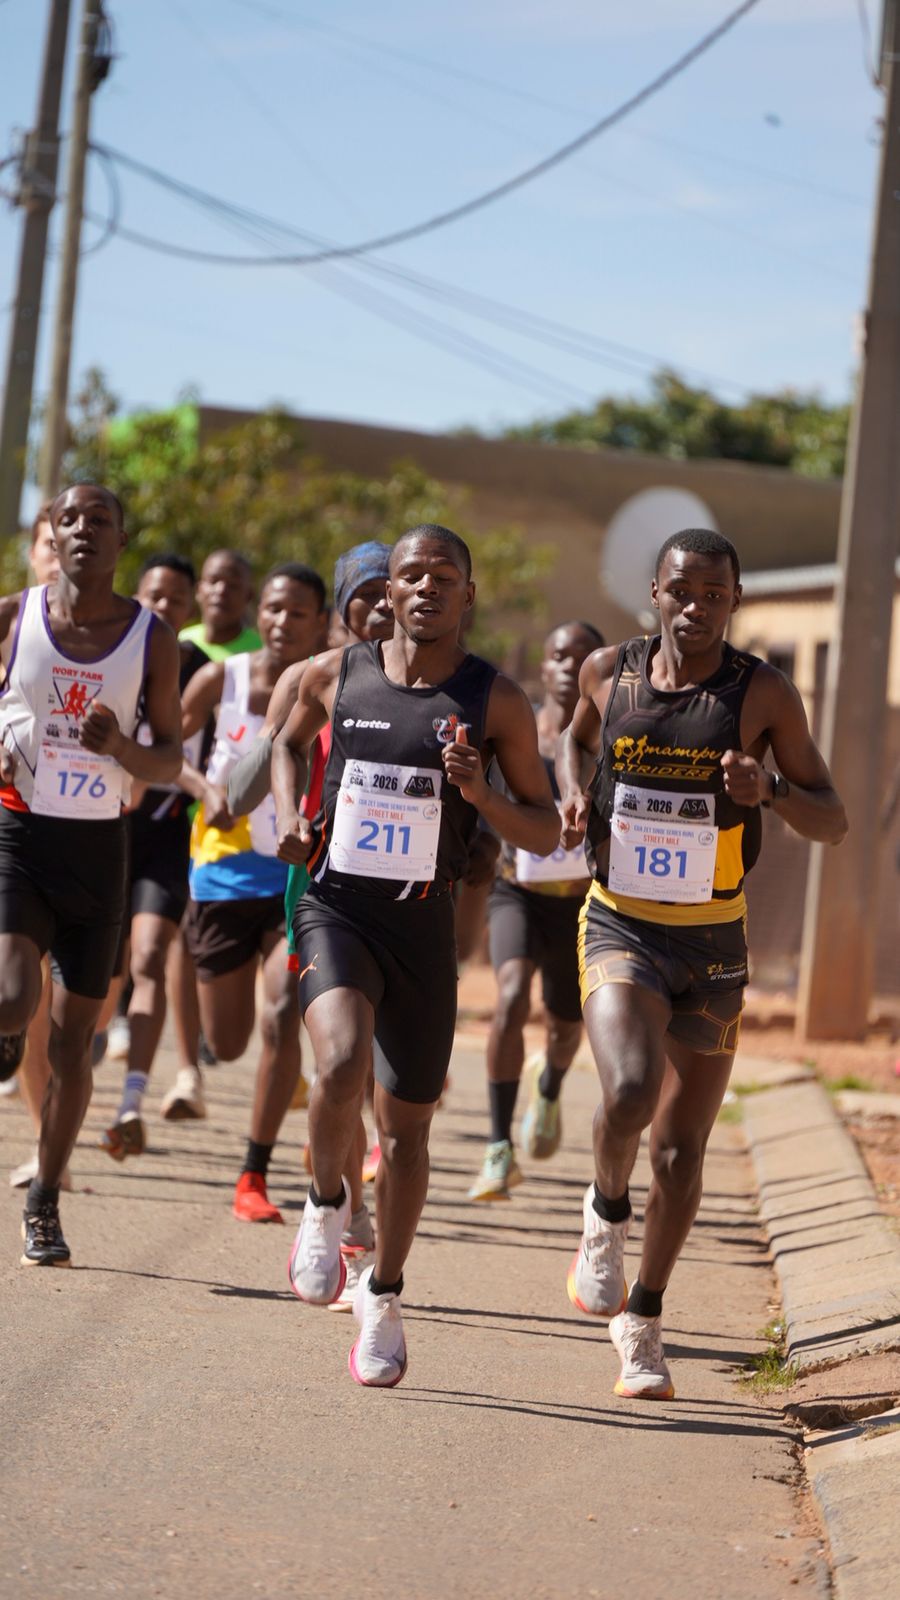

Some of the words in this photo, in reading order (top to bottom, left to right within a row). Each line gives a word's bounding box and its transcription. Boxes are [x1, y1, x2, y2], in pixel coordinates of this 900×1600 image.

[52, 666, 79, 677] IVORY
[80, 670, 104, 681] PARK
[355, 720, 391, 729] lotto
[612, 762, 714, 778] STRIDERS
[57, 771, 107, 799] 176
[373, 774, 398, 792] 2026
[408, 777, 433, 790] ASA
[367, 808, 389, 819] STREET
[390, 811, 404, 821] MILE
[646, 798, 673, 815] 2026
[682, 800, 706, 812] ASA
[356, 820, 411, 856] 211
[643, 834, 665, 844] STREET
[666, 837, 680, 846] MILE
[634, 846, 688, 879] 181
